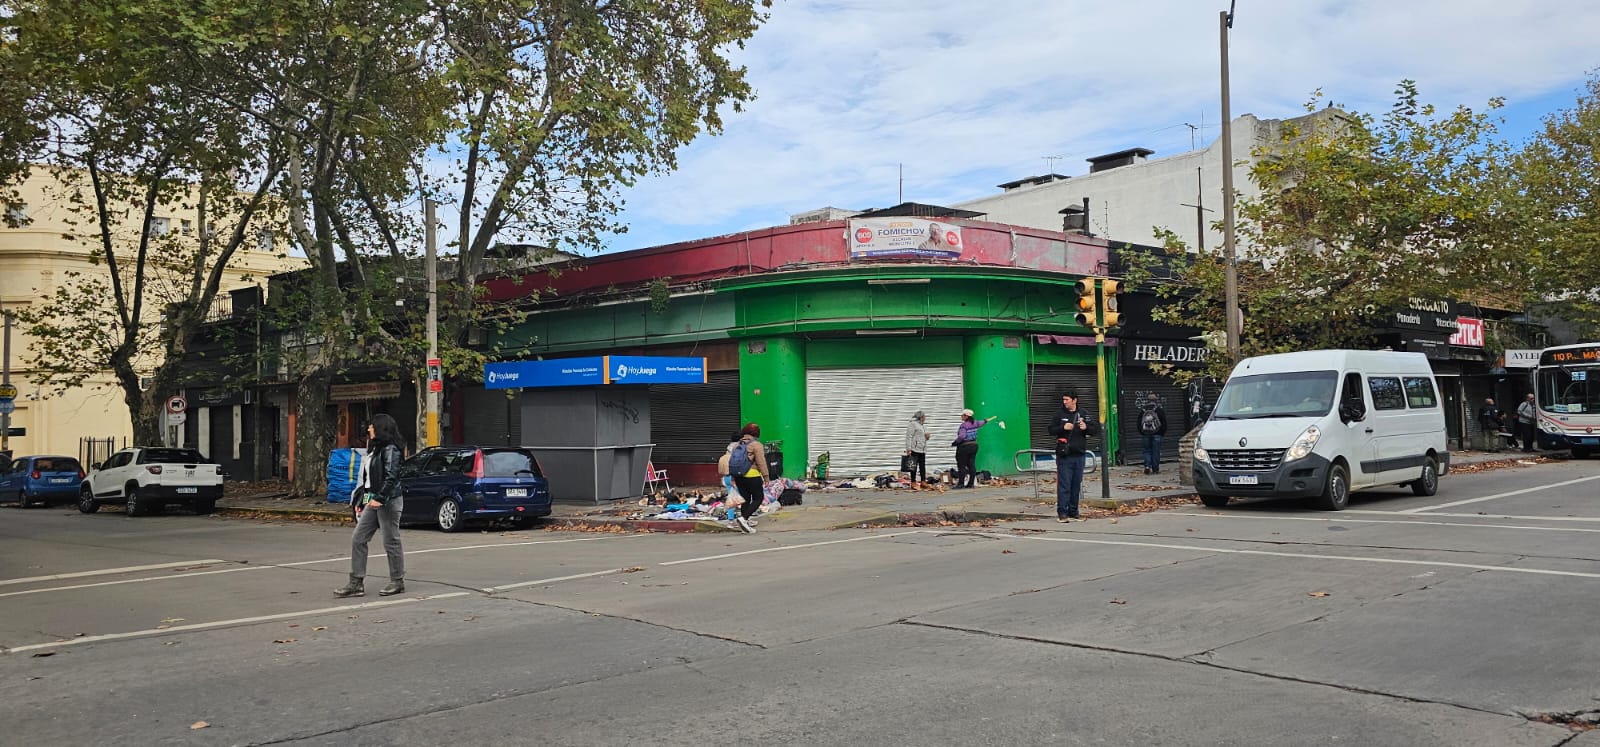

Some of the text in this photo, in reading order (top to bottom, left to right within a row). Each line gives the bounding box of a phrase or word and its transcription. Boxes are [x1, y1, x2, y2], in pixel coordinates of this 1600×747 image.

[878, 228, 925, 236] FOMICHOV
[1553, 353, 1565, 361] 110
[628, 366, 657, 376] HoyJuega
